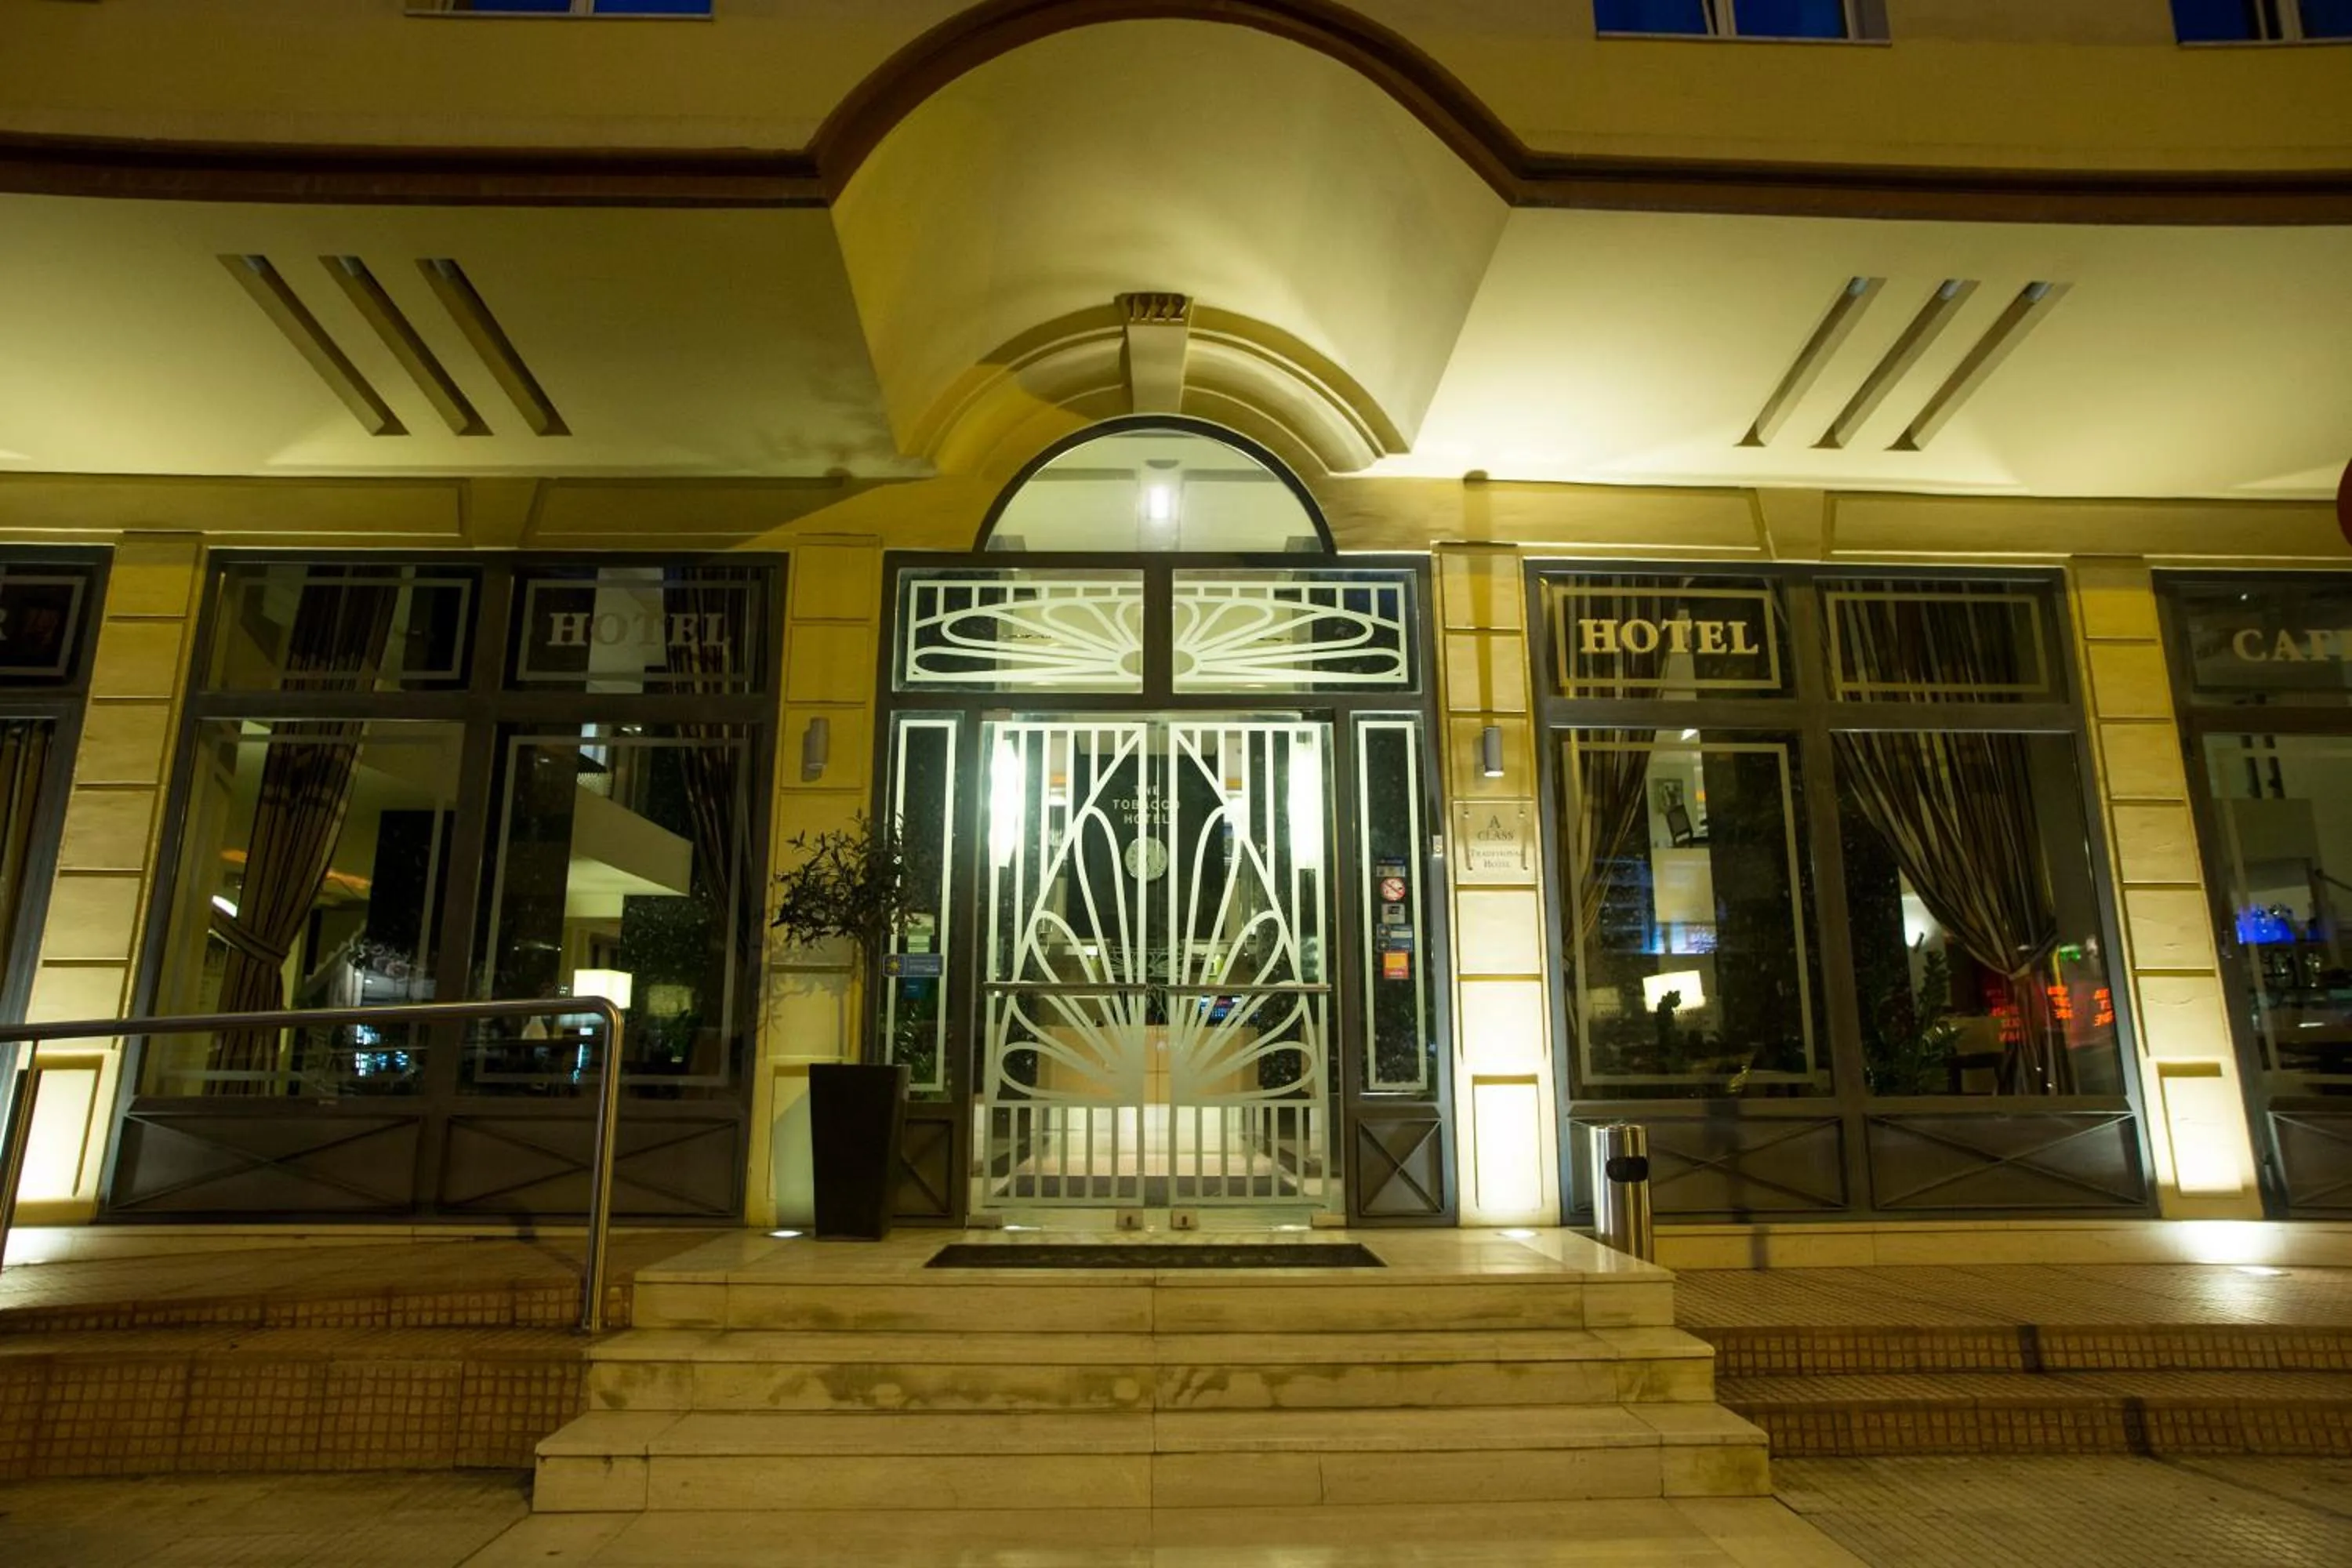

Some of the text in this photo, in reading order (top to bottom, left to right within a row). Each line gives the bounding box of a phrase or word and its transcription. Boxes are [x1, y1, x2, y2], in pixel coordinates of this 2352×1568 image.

[546, 612, 731, 648] HOTEL
[1578, 618, 1759, 655] HOTEL
[1112, 799, 1179, 810] TOBCC
[1488, 815, 1501, 828] A
